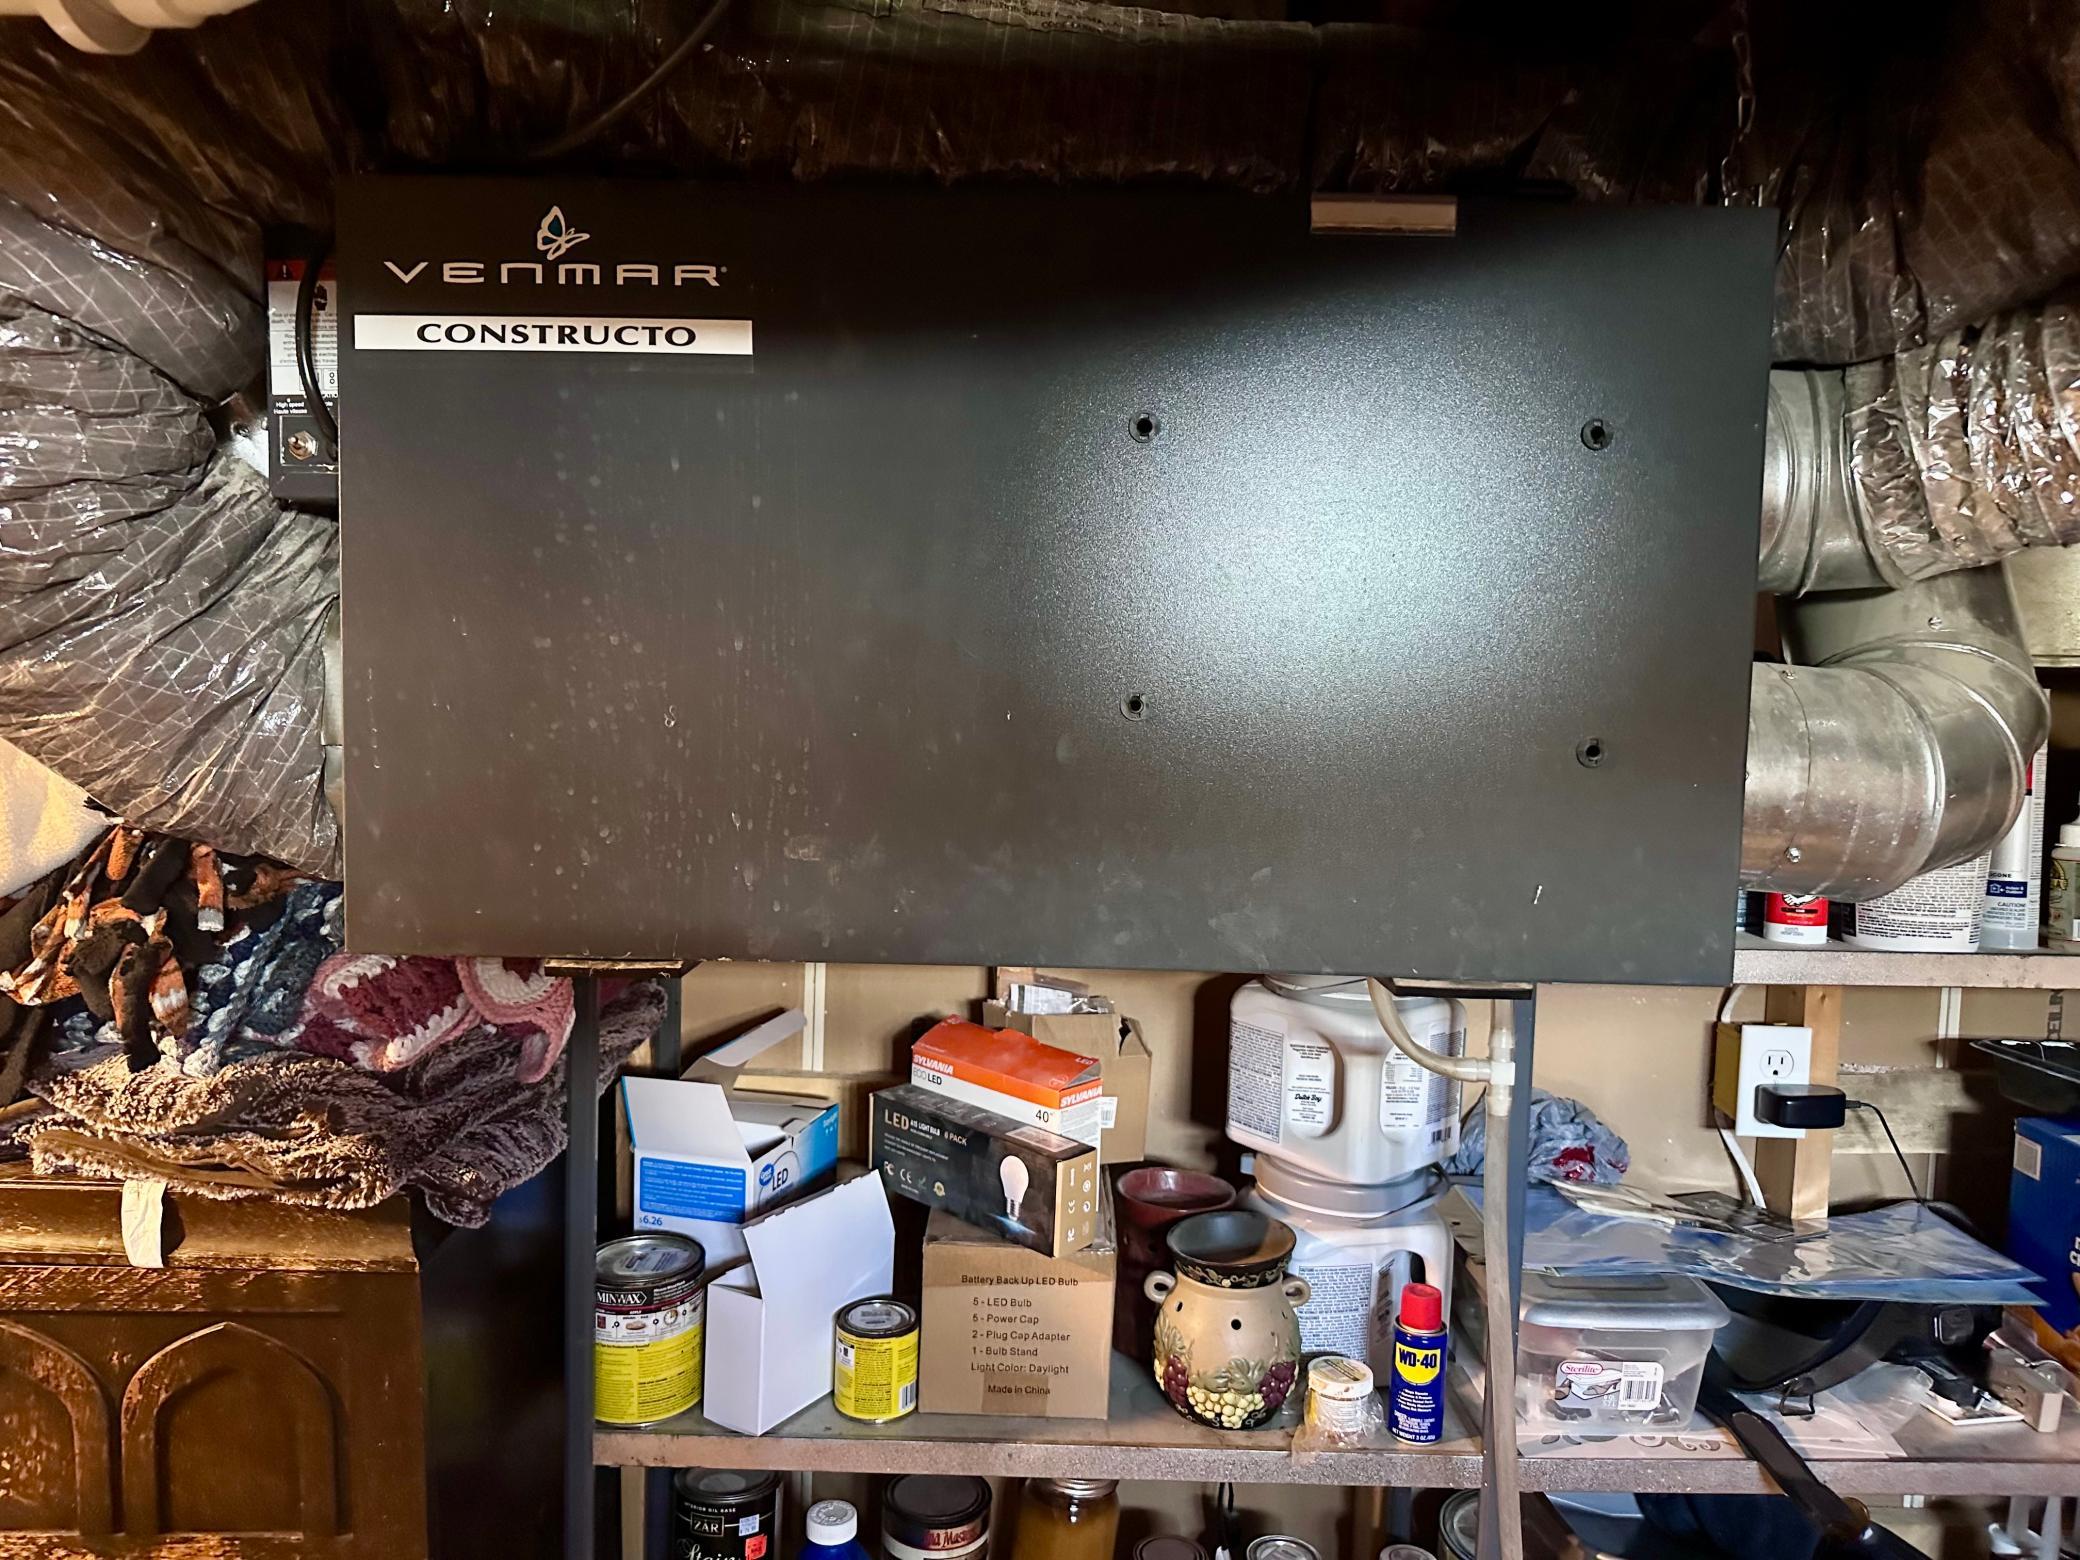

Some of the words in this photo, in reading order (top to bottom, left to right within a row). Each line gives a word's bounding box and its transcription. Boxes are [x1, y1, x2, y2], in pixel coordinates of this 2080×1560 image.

[384, 261, 720, 287] VENMAR
[416, 323, 697, 346] CONSTRUCTO
[912, 1054, 954, 1076] SYLVANIA
[1074, 1056, 1094, 1066] LED
[927, 1074, 943, 1086] LED
[1060, 1085, 1103, 1107] SYLVANIA
[884, 1108, 910, 1131] LED
[949, 1132, 968, 1146] PACK
[772, 1167, 789, 1191] LED
[961, 1275, 994, 1285] Battery
[996, 1275, 1019, 1285] Back
[1021, 1276, 1034, 1286] Up
[1036, 1276, 1055, 1285] LED
[1058, 1277, 1079, 1286] Bulb
[597, 1291, 641, 1304] MINWAX
[987, 1298, 1008, 1307] LED
[1010, 1298, 1032, 1308] Bulb
[986, 1314, 1018, 1323] Power
[1019, 1315, 1039, 1325] Cap
[972, 1330, 978, 1339] 2
[986, 1330, 1008, 1341] Plug
[1010, 1331, 1030, 1342] Cap
[1031, 1331, 1071, 1342] Adapter
[972, 1347, 977, 1355] 1
[985, 1347, 1007, 1356] Bulb
[1009, 1347, 1038, 1357] Stand
[1399, 1347, 1438, 1369] WD-40
[971, 1362, 995, 1373] Light
[997, 1363, 1027, 1373] Color:
[1029, 1364, 1069, 1375] Daylight
[1565, 1363, 1598, 1374] Sterilite
[987, 1385, 1013, 1394] Made
[1014, 1385, 1023, 1394] in
[1024, 1385, 1050, 1395] China
